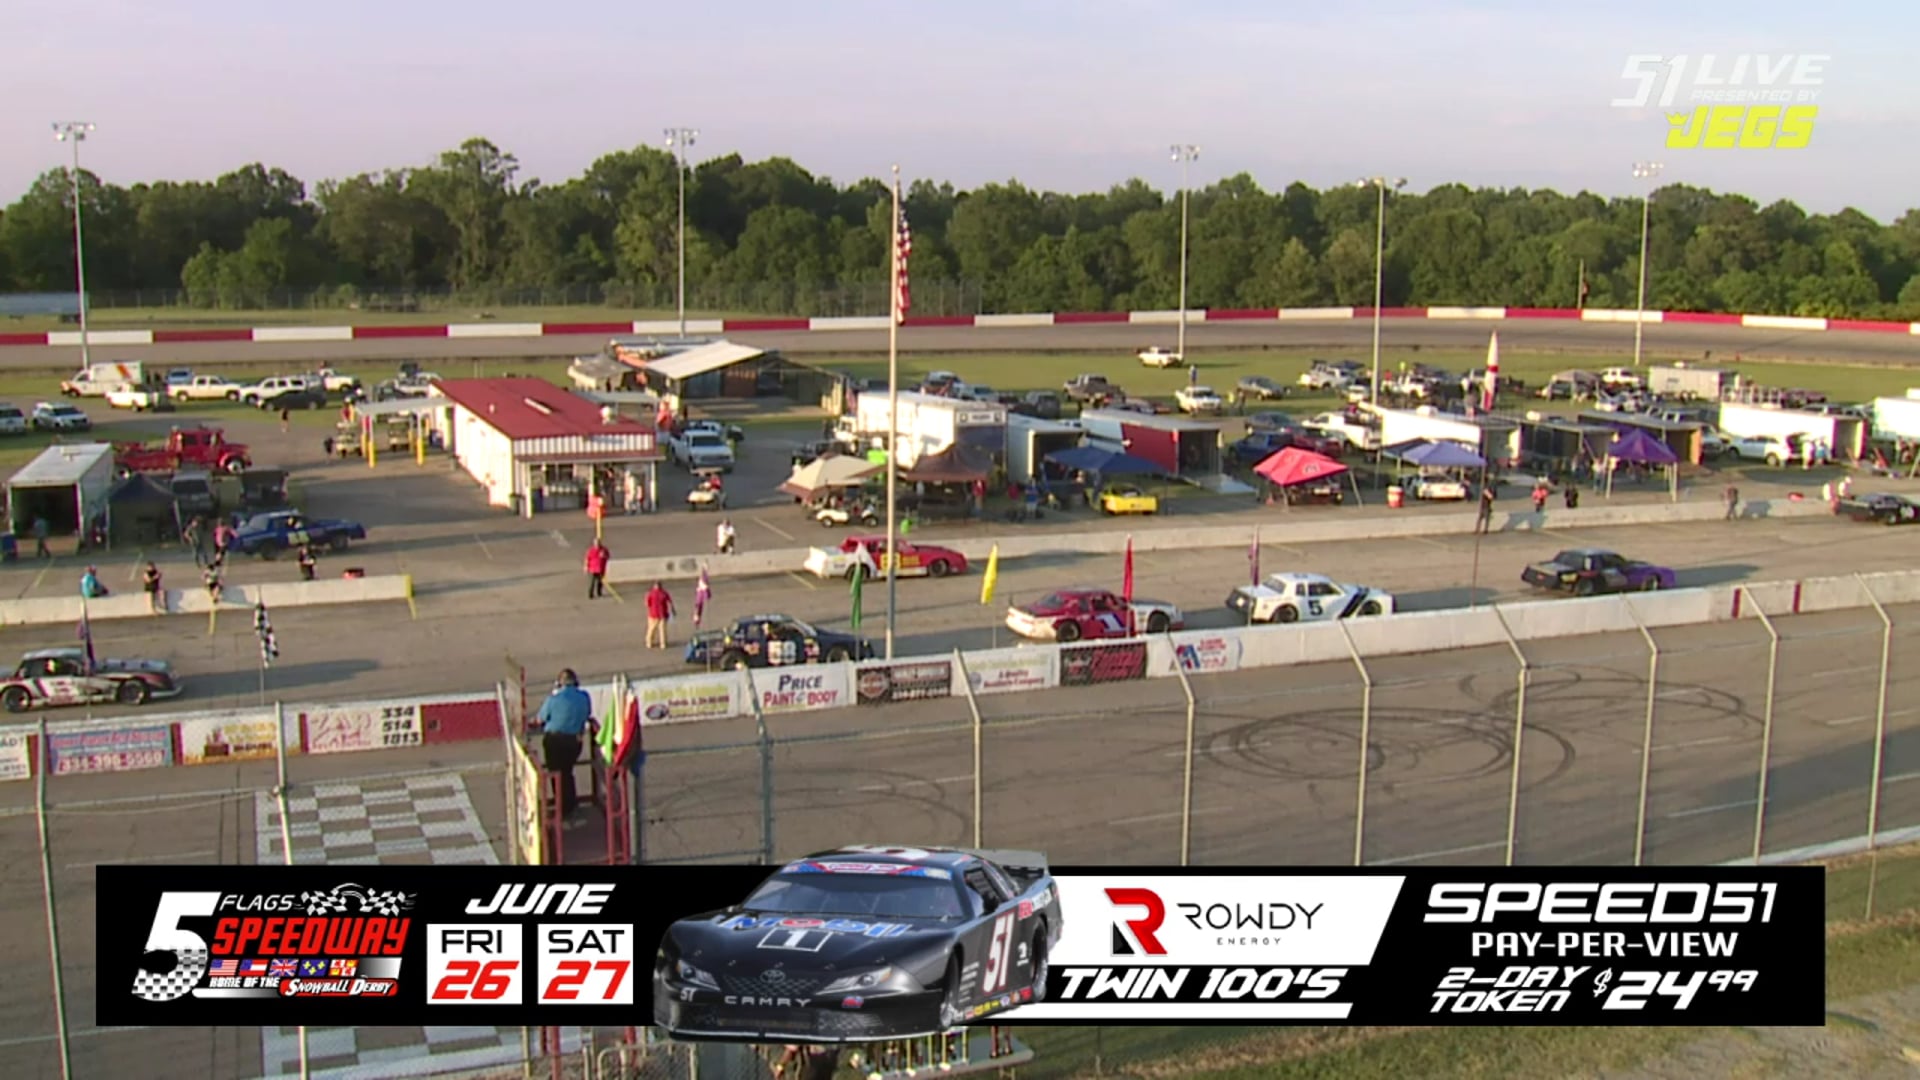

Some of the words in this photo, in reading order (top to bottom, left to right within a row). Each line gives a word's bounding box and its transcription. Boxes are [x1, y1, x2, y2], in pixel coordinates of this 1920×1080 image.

[1308, 599, 1324, 616] 5
[382, 705, 415, 718] 334
[382, 719, 412, 732] 514
